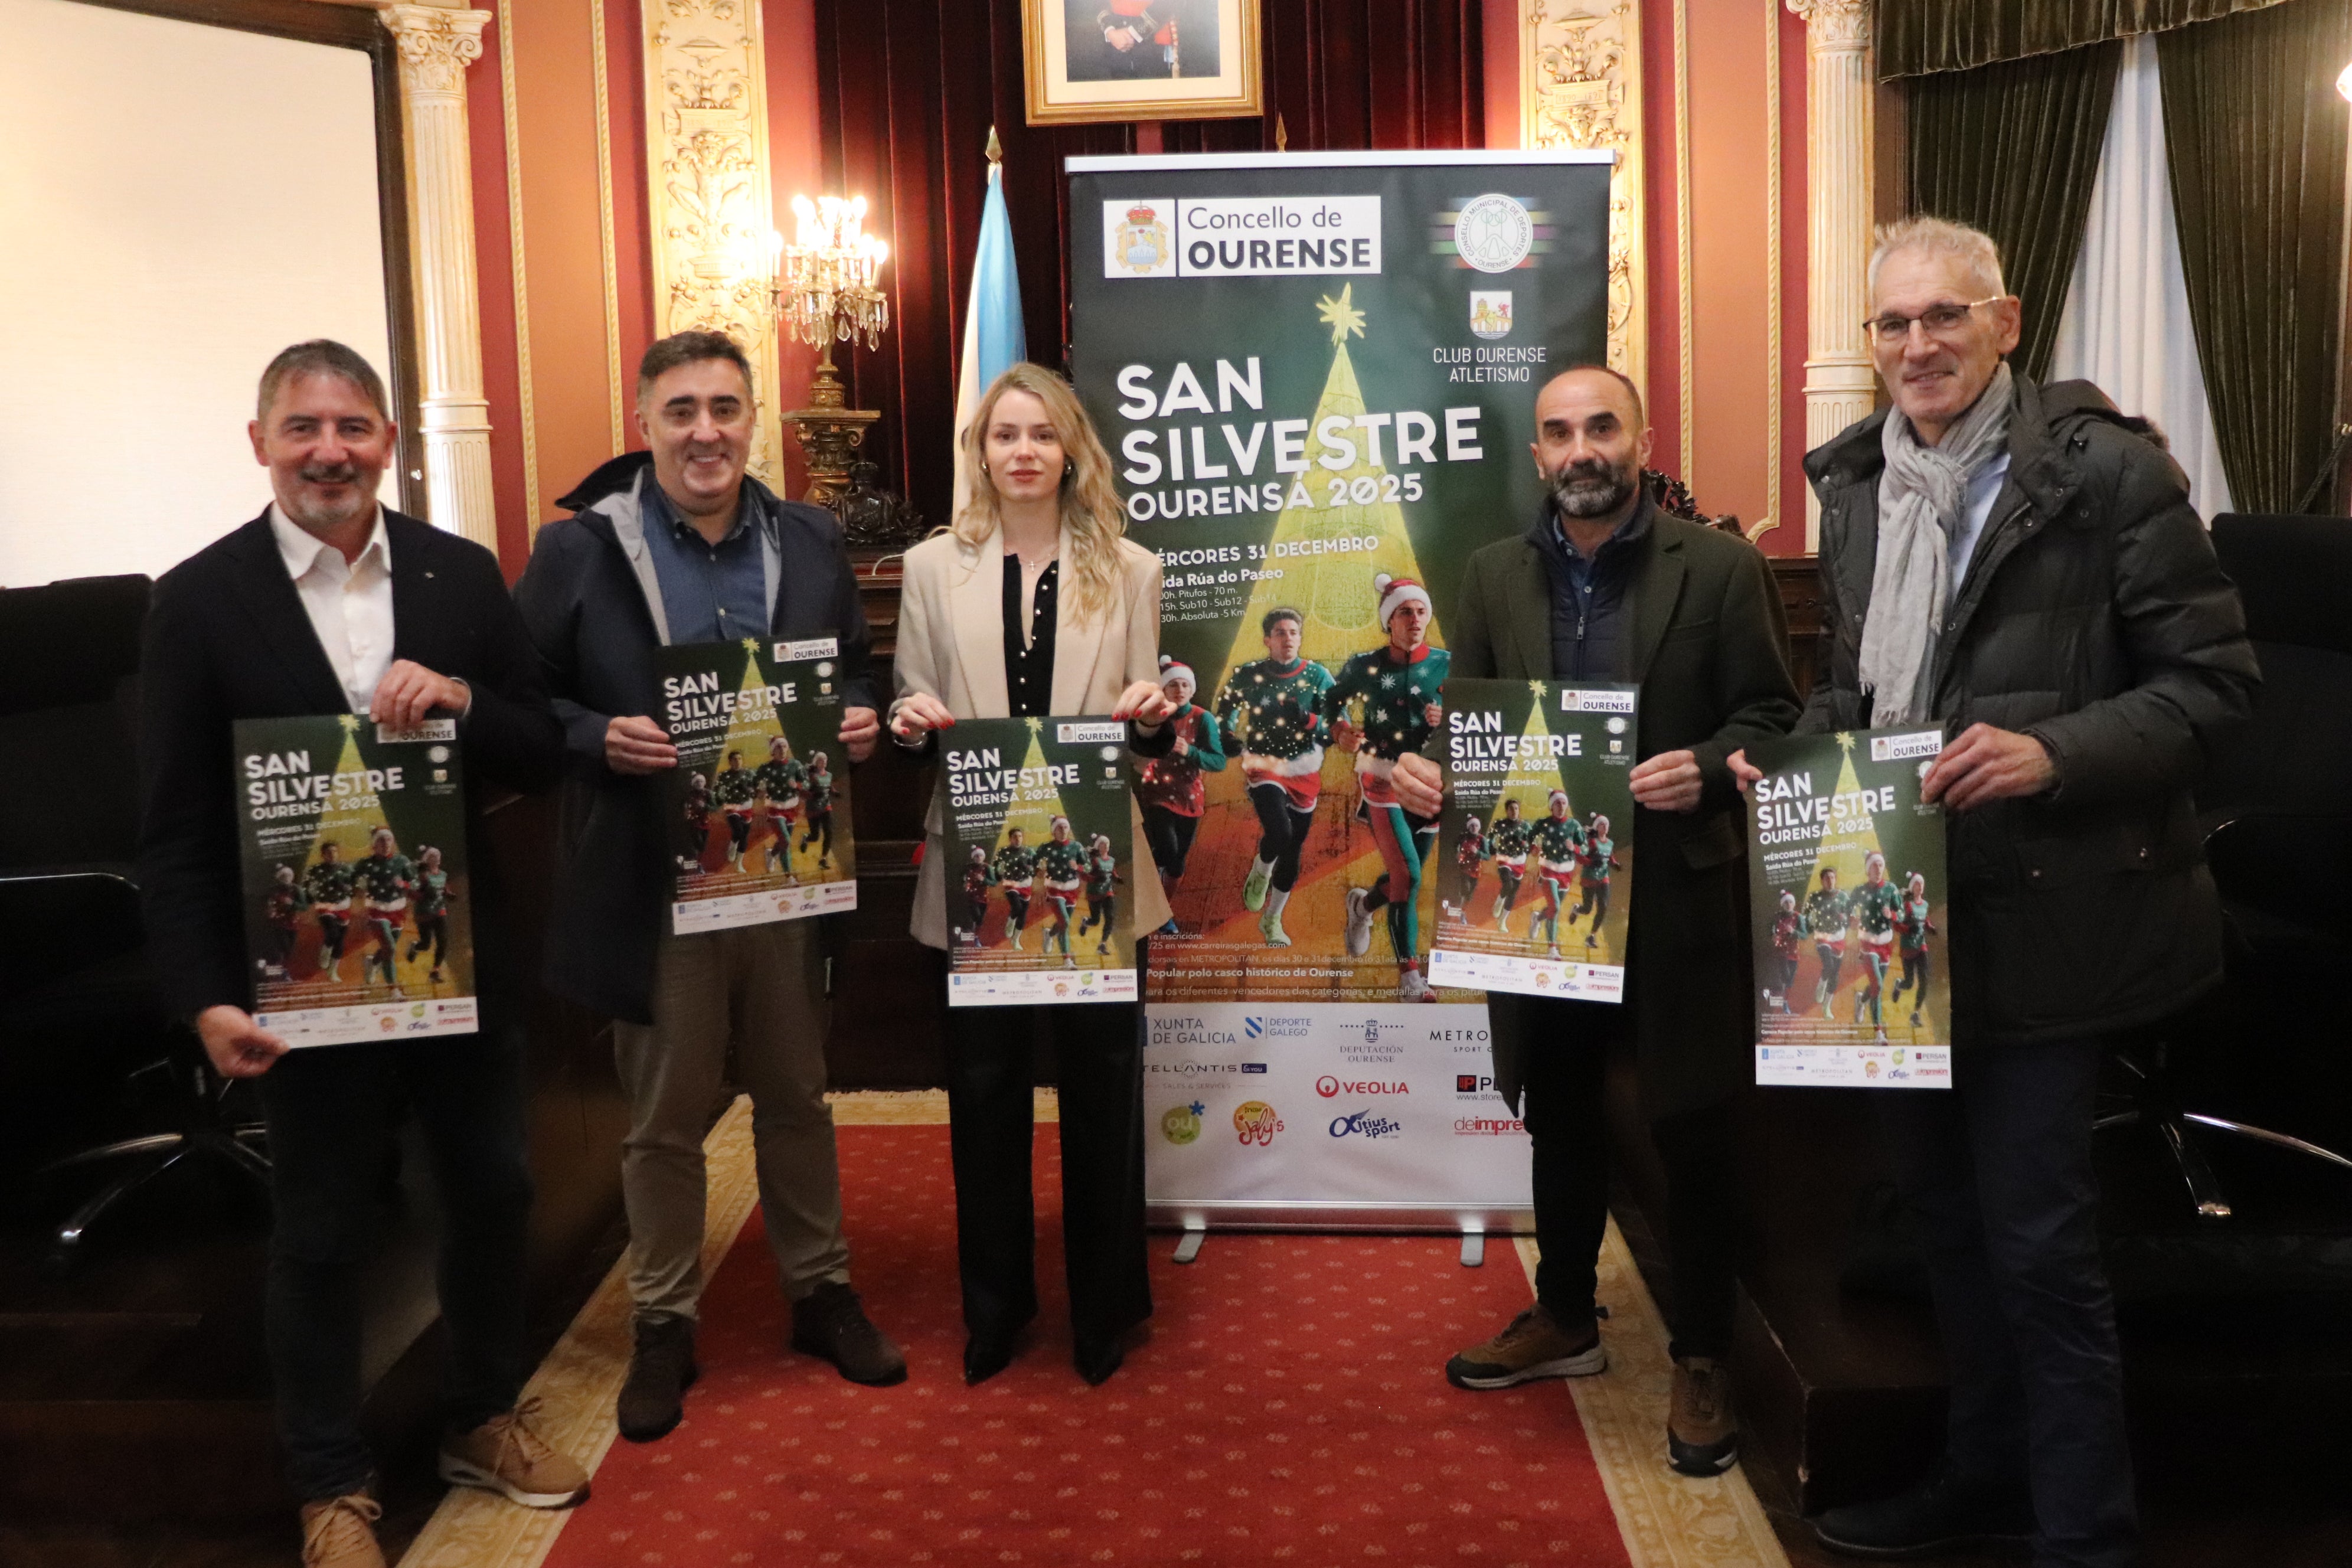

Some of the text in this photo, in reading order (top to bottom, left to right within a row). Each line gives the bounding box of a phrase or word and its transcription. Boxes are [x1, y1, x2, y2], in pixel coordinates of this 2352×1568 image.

[1187, 205, 1342, 230] Concello de
[1461, 200, 1527, 257] CONSELLO MUNICIPAL DE DEPORTES
[1188, 238, 1371, 270] OURENSE
[1433, 347, 1547, 363] CLUB OURENSE
[1449, 367, 1530, 383] ATLETISMO
[1116, 357, 1263, 421] SAN
[1121, 406, 1484, 485] SILVESTRE
[1328, 473, 1423, 507] 2025
[1157, 535, 1379, 567] ÉRCORES 31 DECEMBRO
[1187, 571, 1215, 586] Rúa
[1218, 570, 1237, 583] do
[1241, 568, 1284, 582] Paseo
[1179, 589, 1207, 598] Pitufos
[1214, 587, 1225, 595] 70
[1180, 600, 1207, 610] Sub10
[1214, 597, 1242, 607] Sub12
[1249, 594, 1277, 603] Sub14
[1181, 611, 1219, 621] Absoluta
[794, 648, 836, 659] OURENSE
[664, 671, 719, 698] SAN
[667, 682, 797, 721] SILVESTRE
[1583, 701, 1631, 711] OURENSE
[744, 708, 777, 723] 2025
[1449, 711, 1501, 734] SAN
[1450, 734, 1582, 758] SILVESTRE
[1893, 743, 1939, 757] OURENSE
[244, 750, 311, 779] SAN
[946, 748, 1001, 771] SAN
[1523, 759, 1559, 771] 2025
[247, 767, 405, 805] SILVESTRE
[949, 764, 1080, 795] SILVESTRE
[1755, 772, 1812, 802] SAN
[1024, 788, 1059, 800] 2025
[339, 795, 380, 811] 2025
[1757, 786, 1896, 829] SILVESTRE
[1837, 817, 1874, 834] 2025
[1816, 842, 1856, 854] DECEMBRO
[1177, 942, 1286, 950] www.carreirasgalegas.com
[1147, 968, 1185, 978] Popular
[1188, 968, 1212, 978] polo
[1246, 968, 1291, 976] histórico
[1293, 968, 1306, 976] de
[1309, 968, 1354, 977] Ourense
[1180, 986, 1228, 995] diferentes
[1233, 986, 1290, 995] vencedores
[1292, 987, 1309, 995] das
[1377, 986, 1420, 995] medallas
[1154, 1018, 1204, 1030] XUNTA
[1154, 1033, 1236, 1044] DE GALICIA
[1343, 1082, 1409, 1094] VEOLIA
[1366, 1122, 1400, 1139] sport
